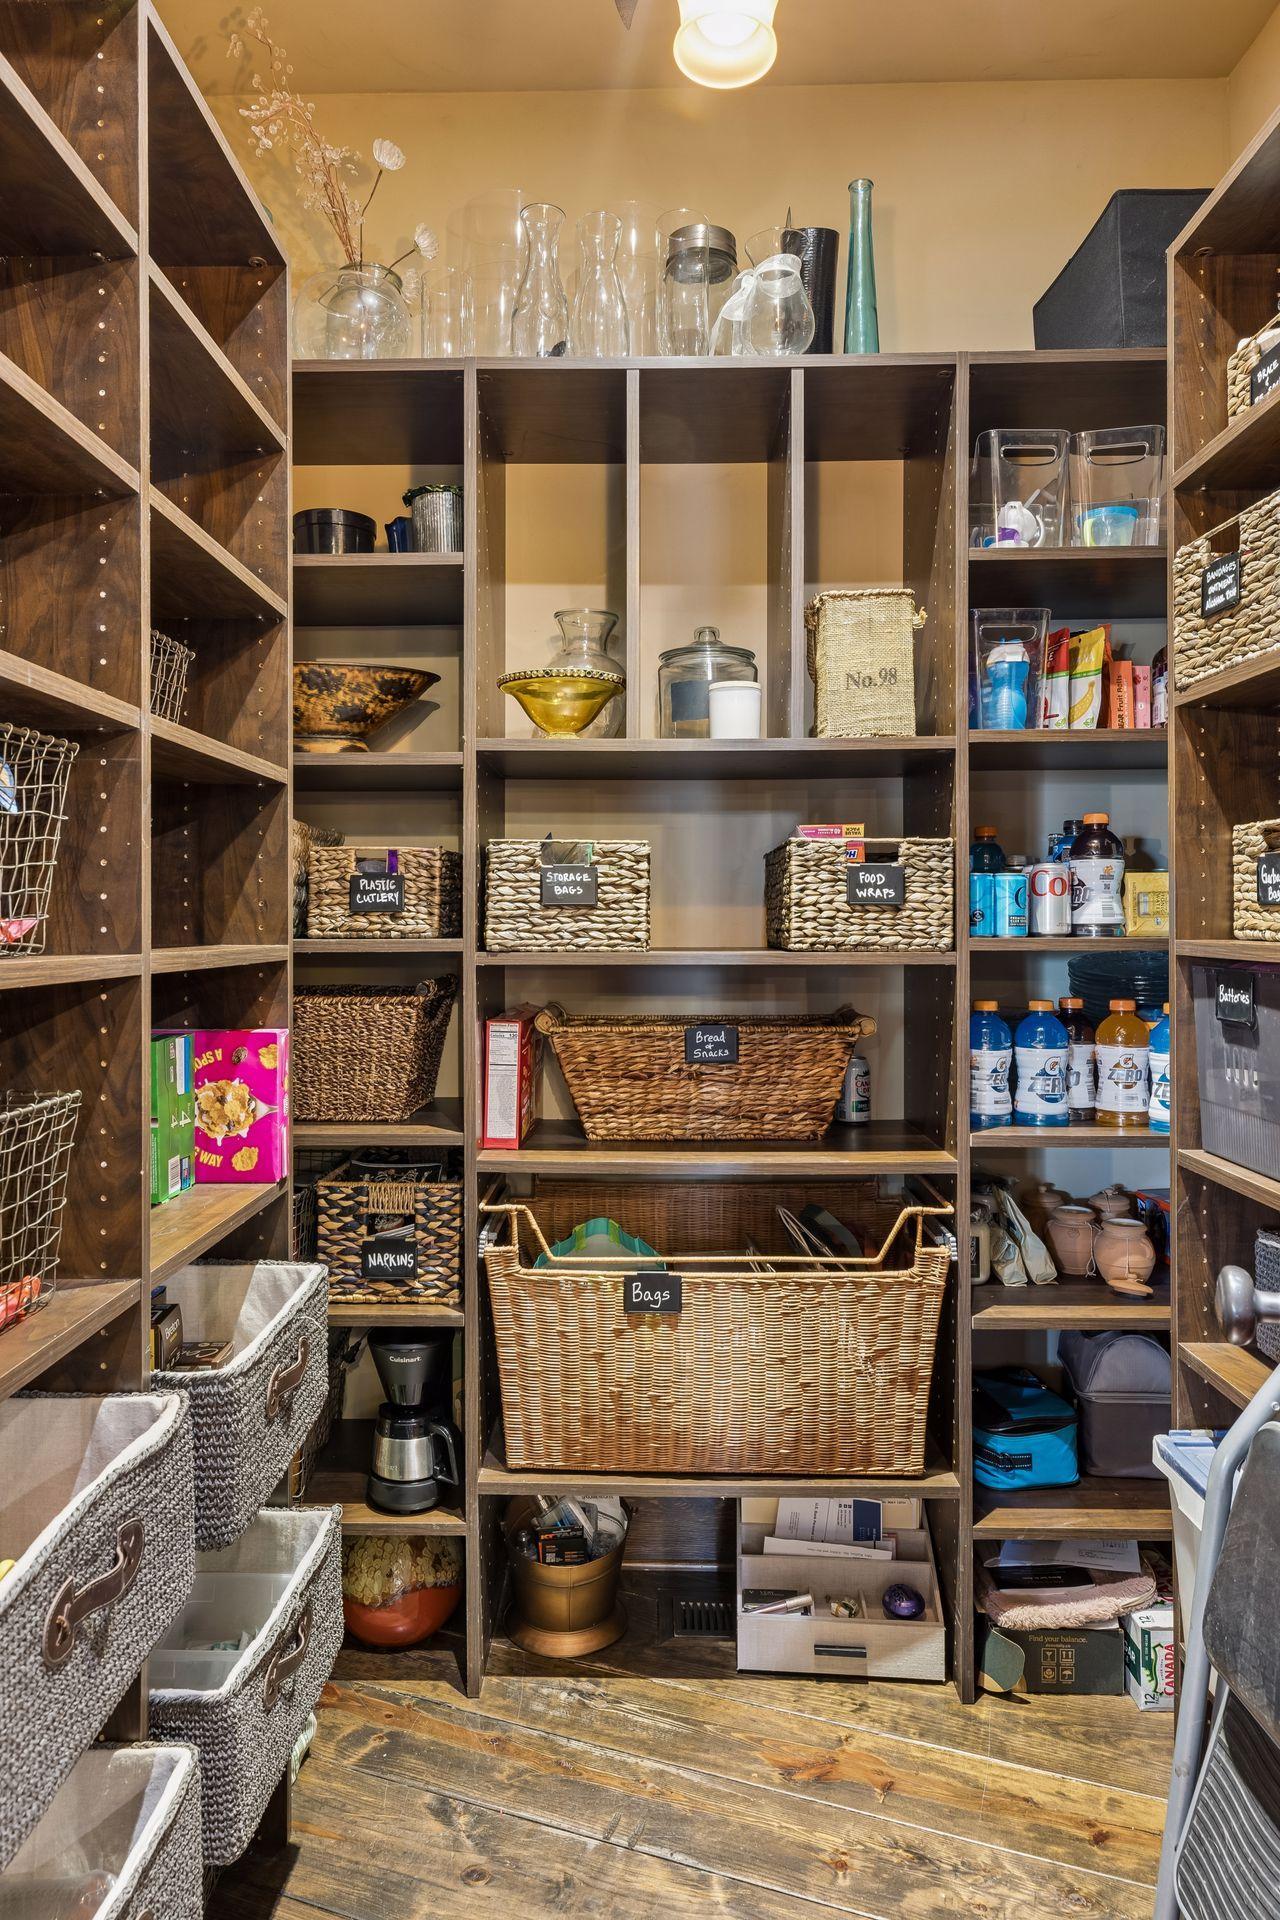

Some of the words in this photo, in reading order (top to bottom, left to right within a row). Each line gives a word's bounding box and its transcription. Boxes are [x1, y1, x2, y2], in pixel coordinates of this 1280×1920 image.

[879, 667, 897, 685] 98
[1116, 694, 1124, 712] Fruit
[546, 871, 591, 882] STORAGE
[859, 872, 885, 885] FOOD
[1031, 869, 1068, 897] Co
[360, 879, 396, 890] PLASTIC
[554, 885, 583, 895] BAGS
[356, 891, 399, 905] CUTLERY
[856, 888, 895, 899] WRAPS
[1219, 984, 1250, 1005] Batteries
[695, 1031, 726, 1043] Bread
[693, 1049, 729, 1058] Snacks
[195, 1051, 215, 1072] SPO
[1107, 1068, 1143, 1082] ZERO
[200, 1150, 223, 1168] WAY
[368, 1253, 415, 1272] NAPKINS
[632, 1282, 671, 1308] Bags
[389, 1355, 421, 1363] Cuisinart
[1044, 1636, 1060, 1644] your
[1163, 1643, 1174, 1696] CANADA
[1144, 1693, 1155, 1705] 12
